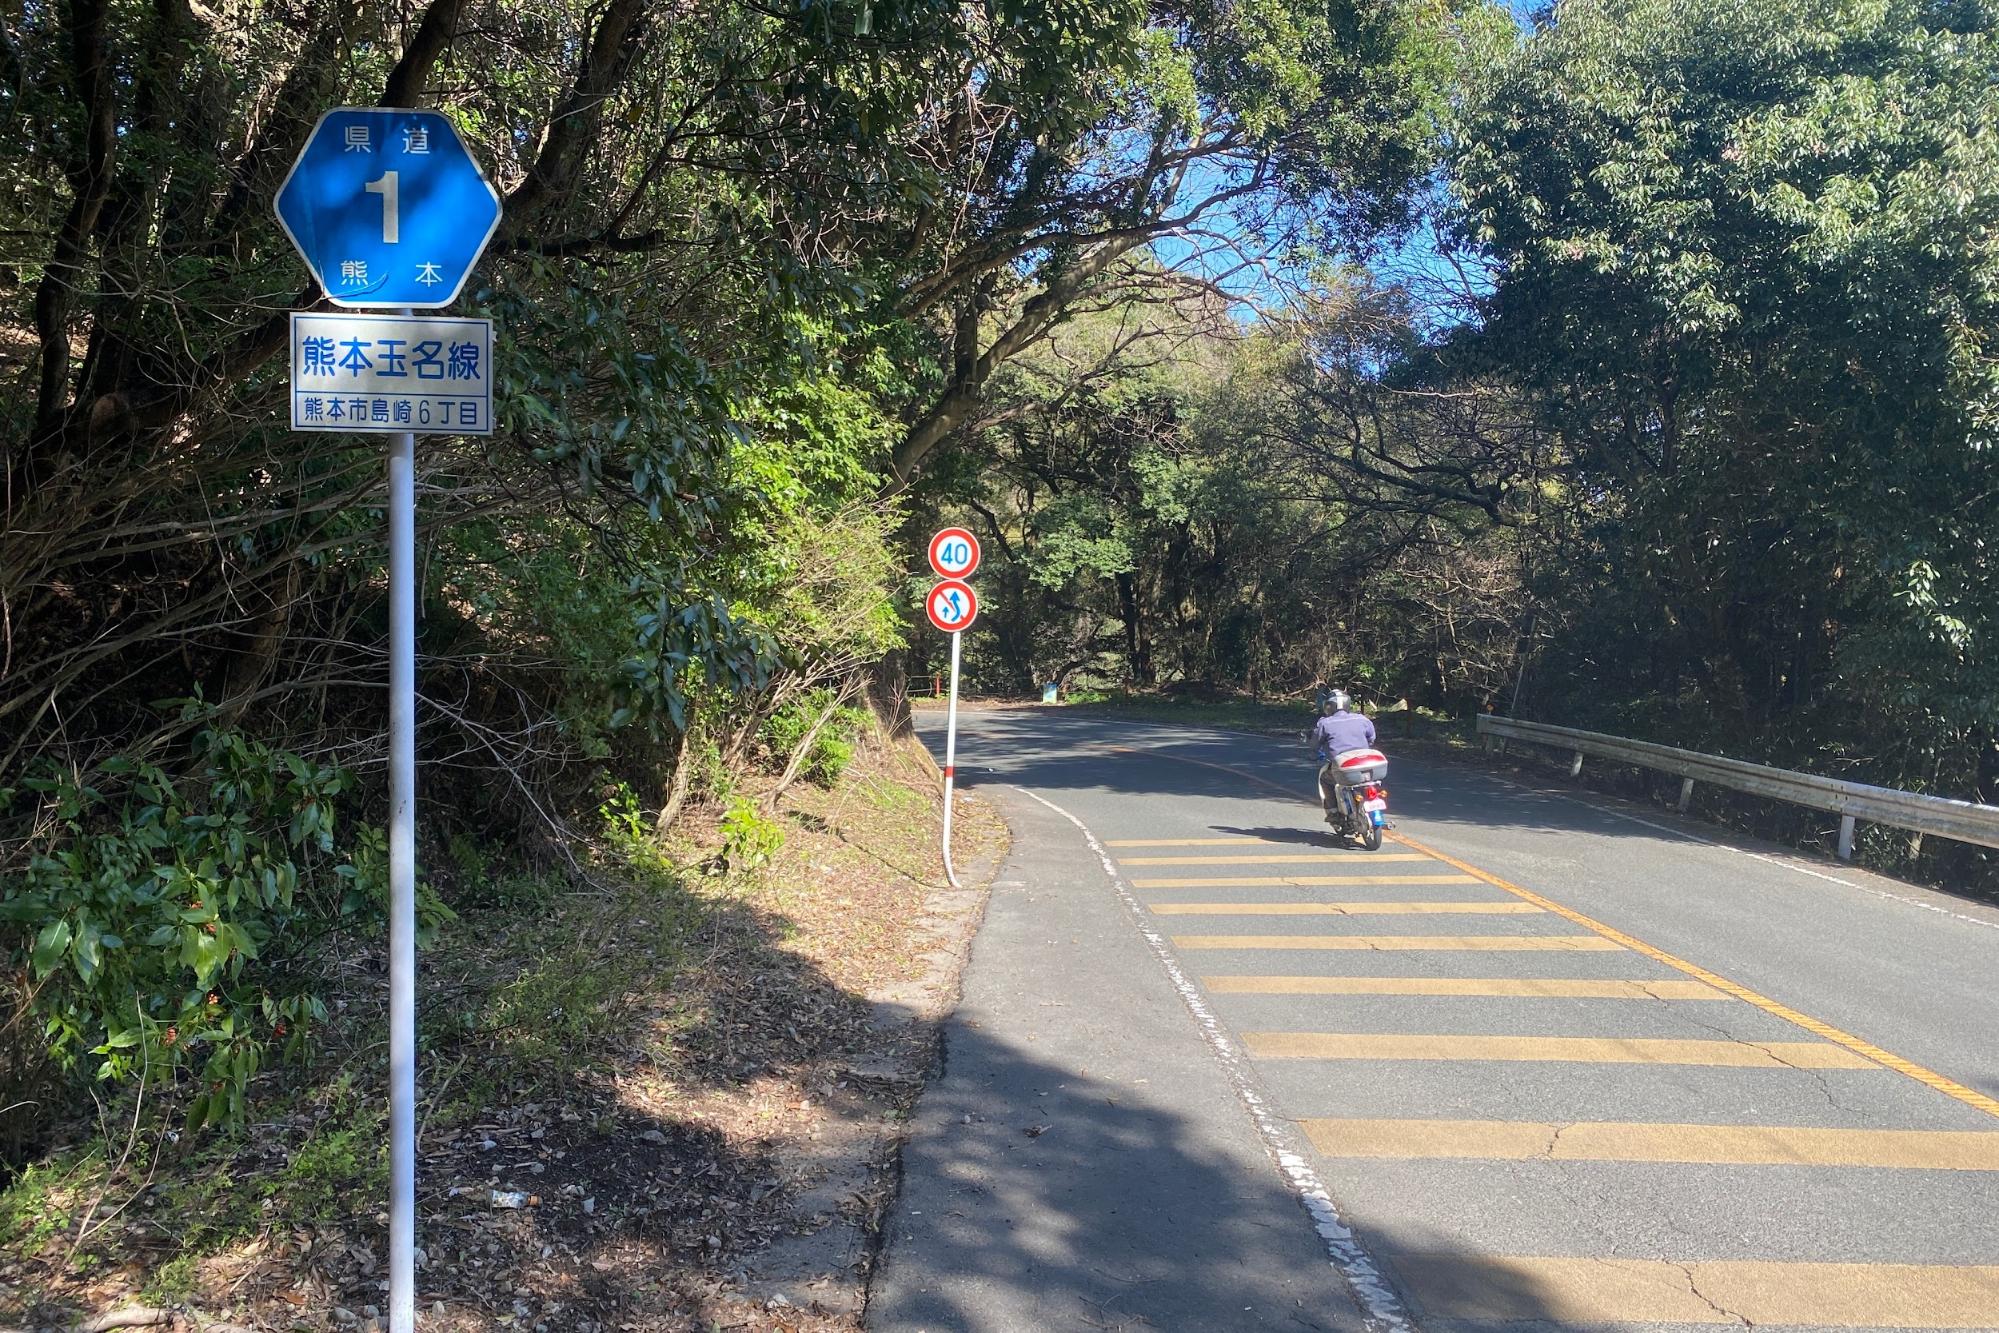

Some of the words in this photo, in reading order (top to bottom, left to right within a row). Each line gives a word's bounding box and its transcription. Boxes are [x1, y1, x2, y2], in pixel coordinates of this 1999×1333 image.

[344, 126, 430, 154] 県道
[365, 171, 399, 243] 1
[340, 260, 443, 287] 熊本
[303, 336, 480, 380] 熊本玉名線
[304, 397, 477, 425] 熊本市島崎6丁目
[941, 543, 968, 564] 40
